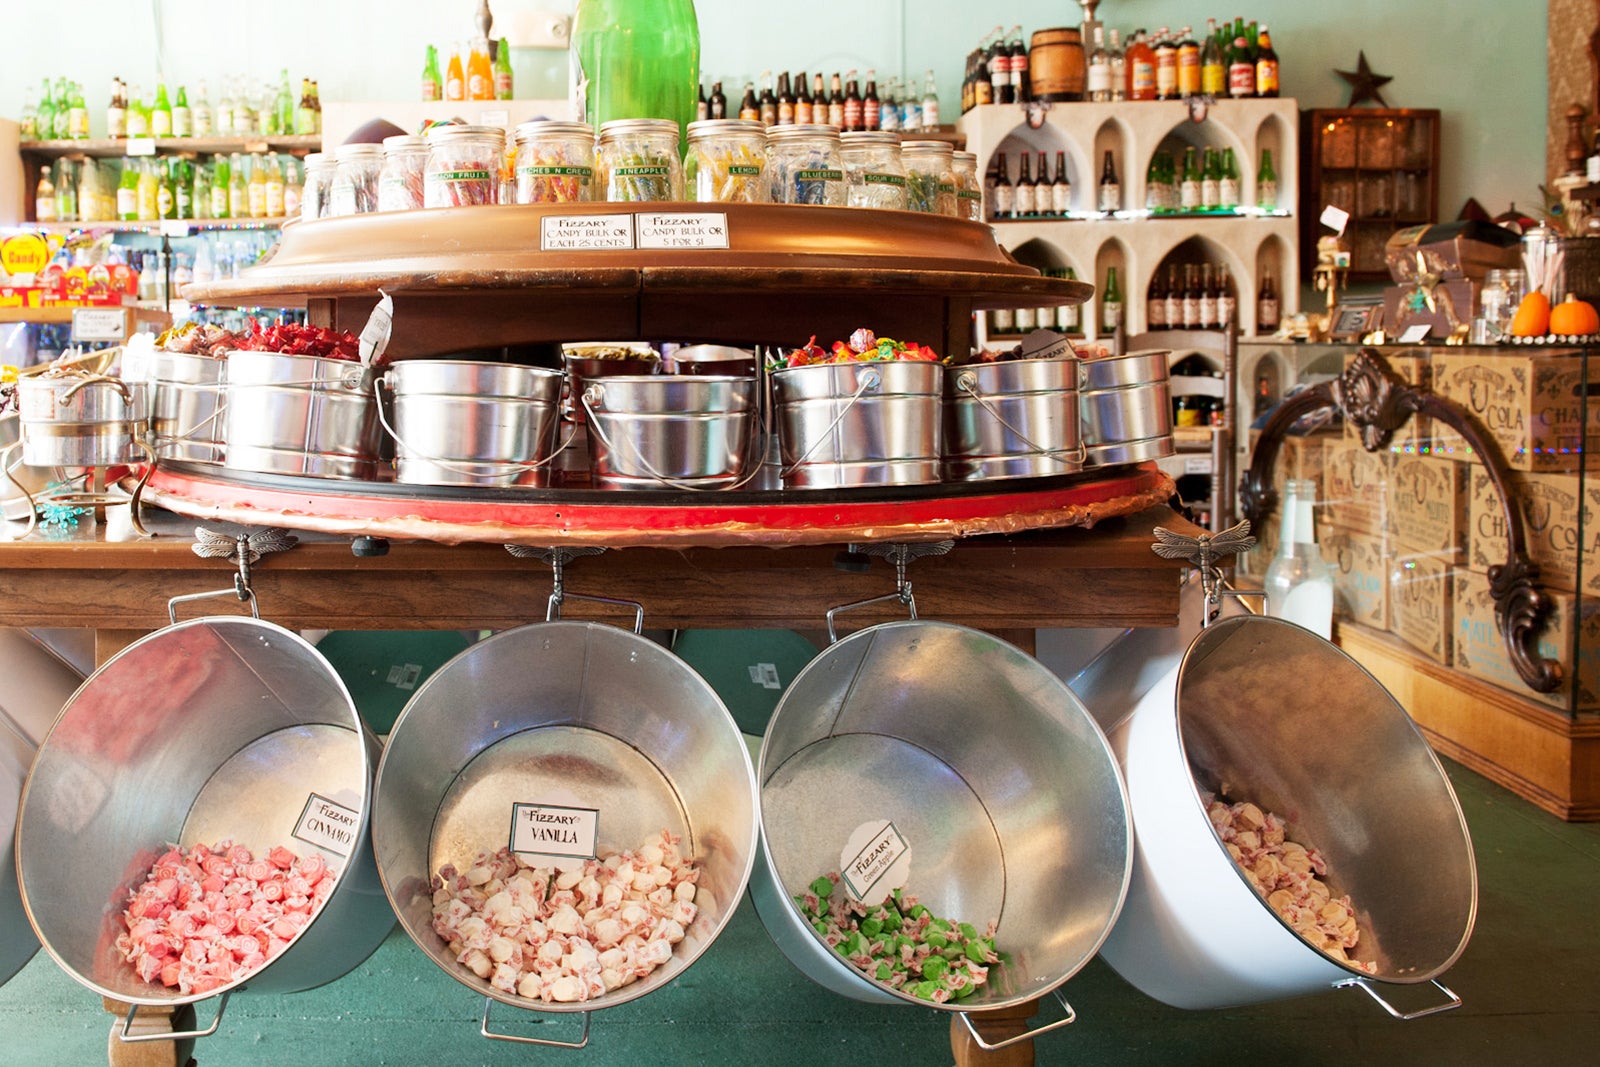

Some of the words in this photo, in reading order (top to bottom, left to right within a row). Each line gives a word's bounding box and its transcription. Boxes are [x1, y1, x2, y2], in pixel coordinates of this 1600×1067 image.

[615, 167, 666, 175] PINEAPPLE
[558, 220, 608, 228] FIZZARY
[652, 217, 703, 226] FIZZARY
[546, 230, 581, 238] CANDY
[642, 228, 677, 237] CANDY
[681, 228, 705, 236] BULK
[708, 227, 723, 236] OR
[549, 240, 575, 248] EACH
[672, 238, 692, 246] FOR
[1487, 404, 1524, 431] COLA
[320, 804, 355, 827] FIZZARY
[529, 810, 578, 825] FIZZARY
[307, 818, 355, 845] CINNAMO
[531, 827, 577, 843] VANILLA
[856, 838, 891, 874] FIZZARY
[863, 865, 880, 883] Green
[879, 850, 894, 869] Apple
